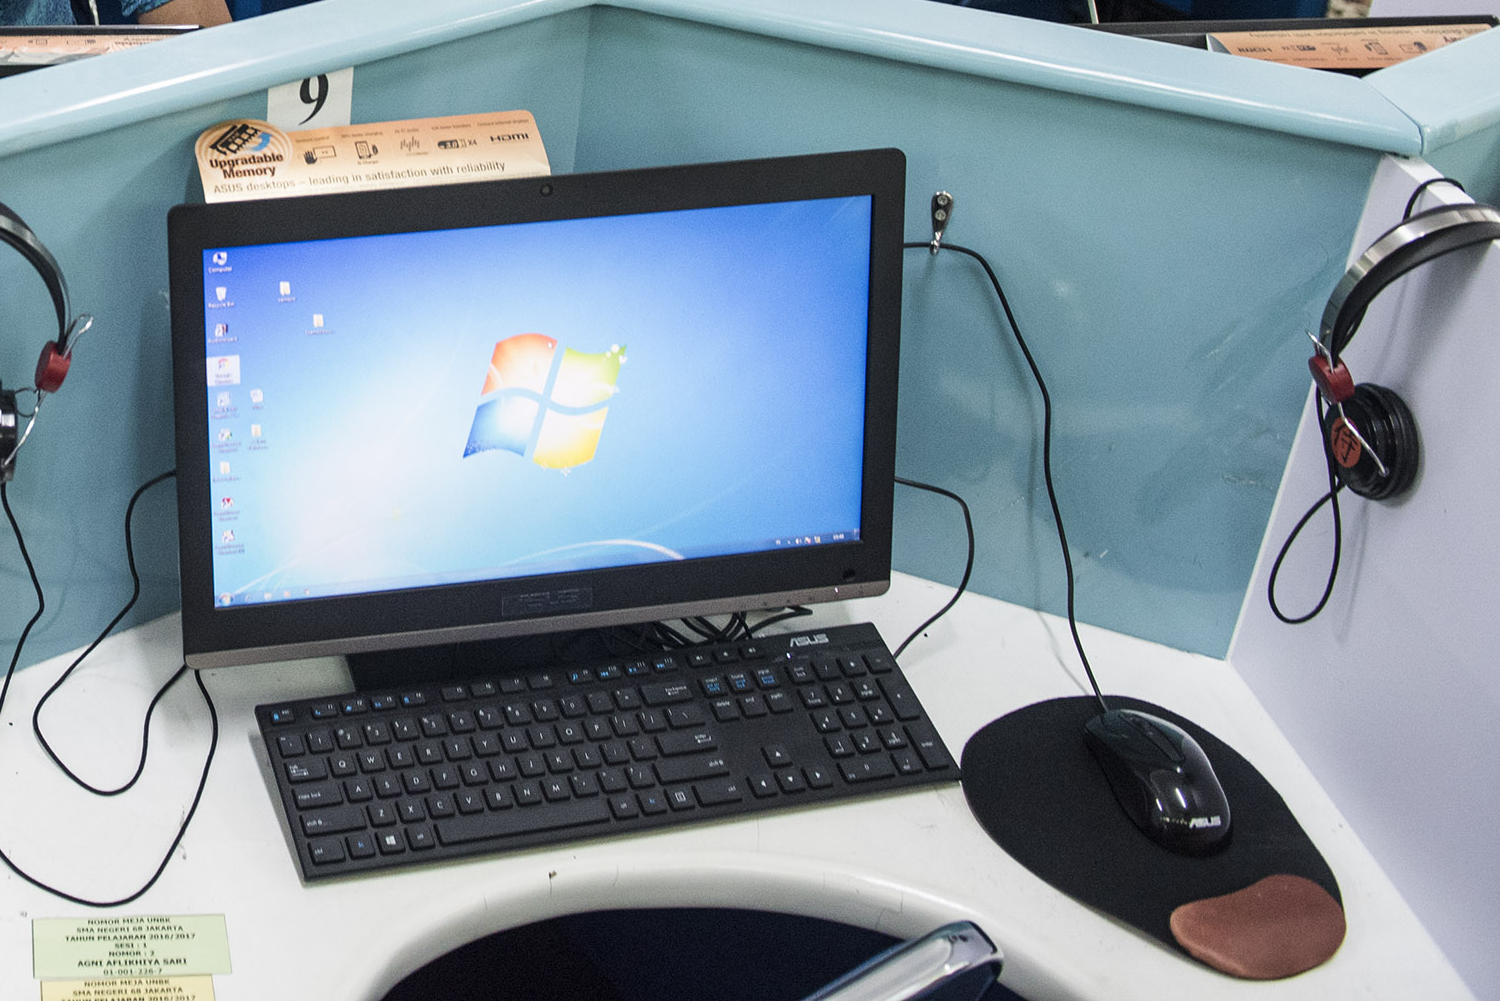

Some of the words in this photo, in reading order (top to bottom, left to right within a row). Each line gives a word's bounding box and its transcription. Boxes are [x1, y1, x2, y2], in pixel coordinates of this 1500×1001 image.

[299, 73, 329, 126] 9
[490, 133, 529, 142] HDMI
[209, 152, 284, 169] Upgradable
[213, 183, 243, 194] ASUS
[246, 178, 296, 192] desktops
[308, 173, 349, 186] leading
[352, 173, 362, 183] in
[364, 168, 427, 181] satisfaction
[430, 166, 453, 177] with
[456, 161, 506, 175] reliability
[223, 166, 276, 179] Memory
[789, 633, 829, 647] ASUS
[1189, 815, 1222, 828] ASUS
